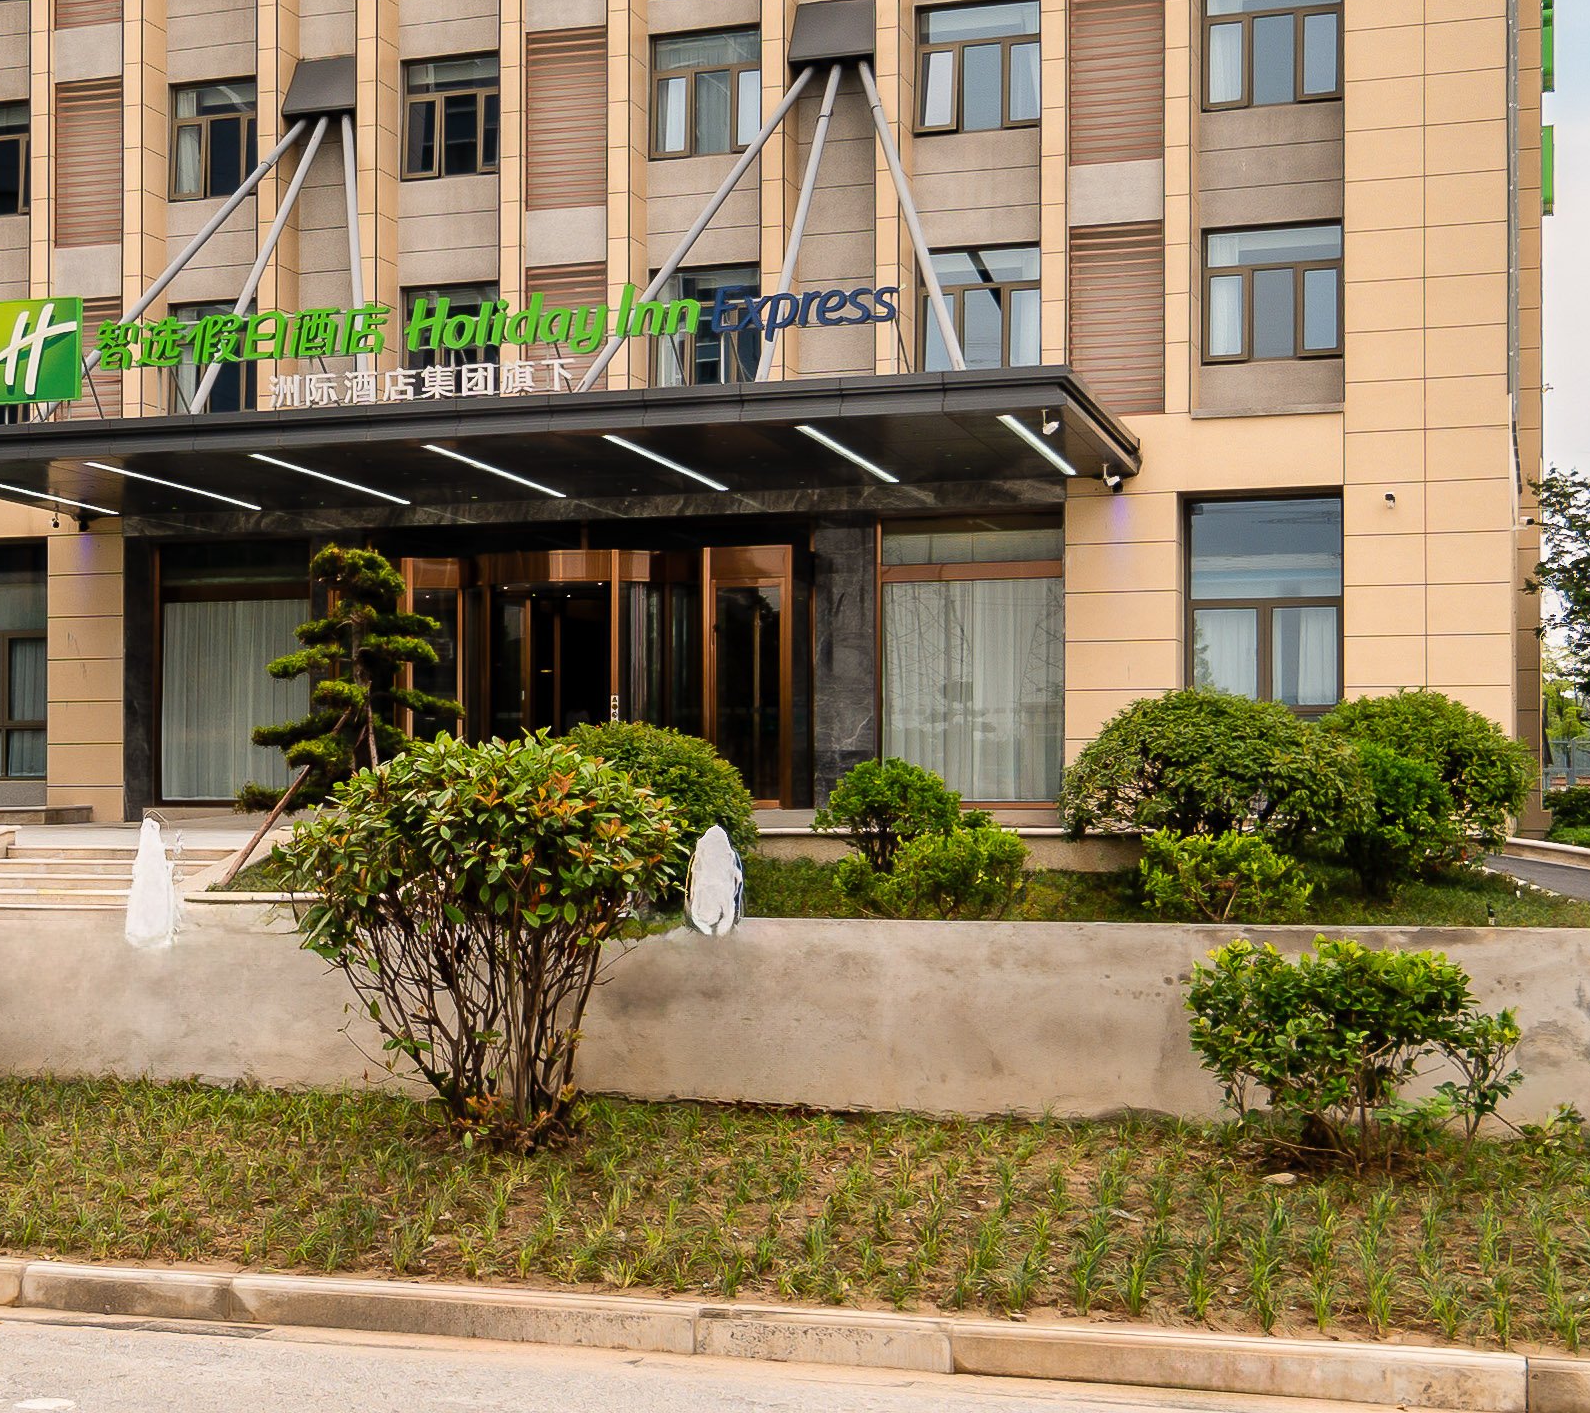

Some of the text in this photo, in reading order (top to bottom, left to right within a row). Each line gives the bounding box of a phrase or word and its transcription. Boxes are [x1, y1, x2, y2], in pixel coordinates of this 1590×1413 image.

[95, 303, 391, 371] 智选假日酒店
[404, 283, 900, 355] Holiday Inn Express
[268, 357, 576, 408] 洲际酒店集团旗下
